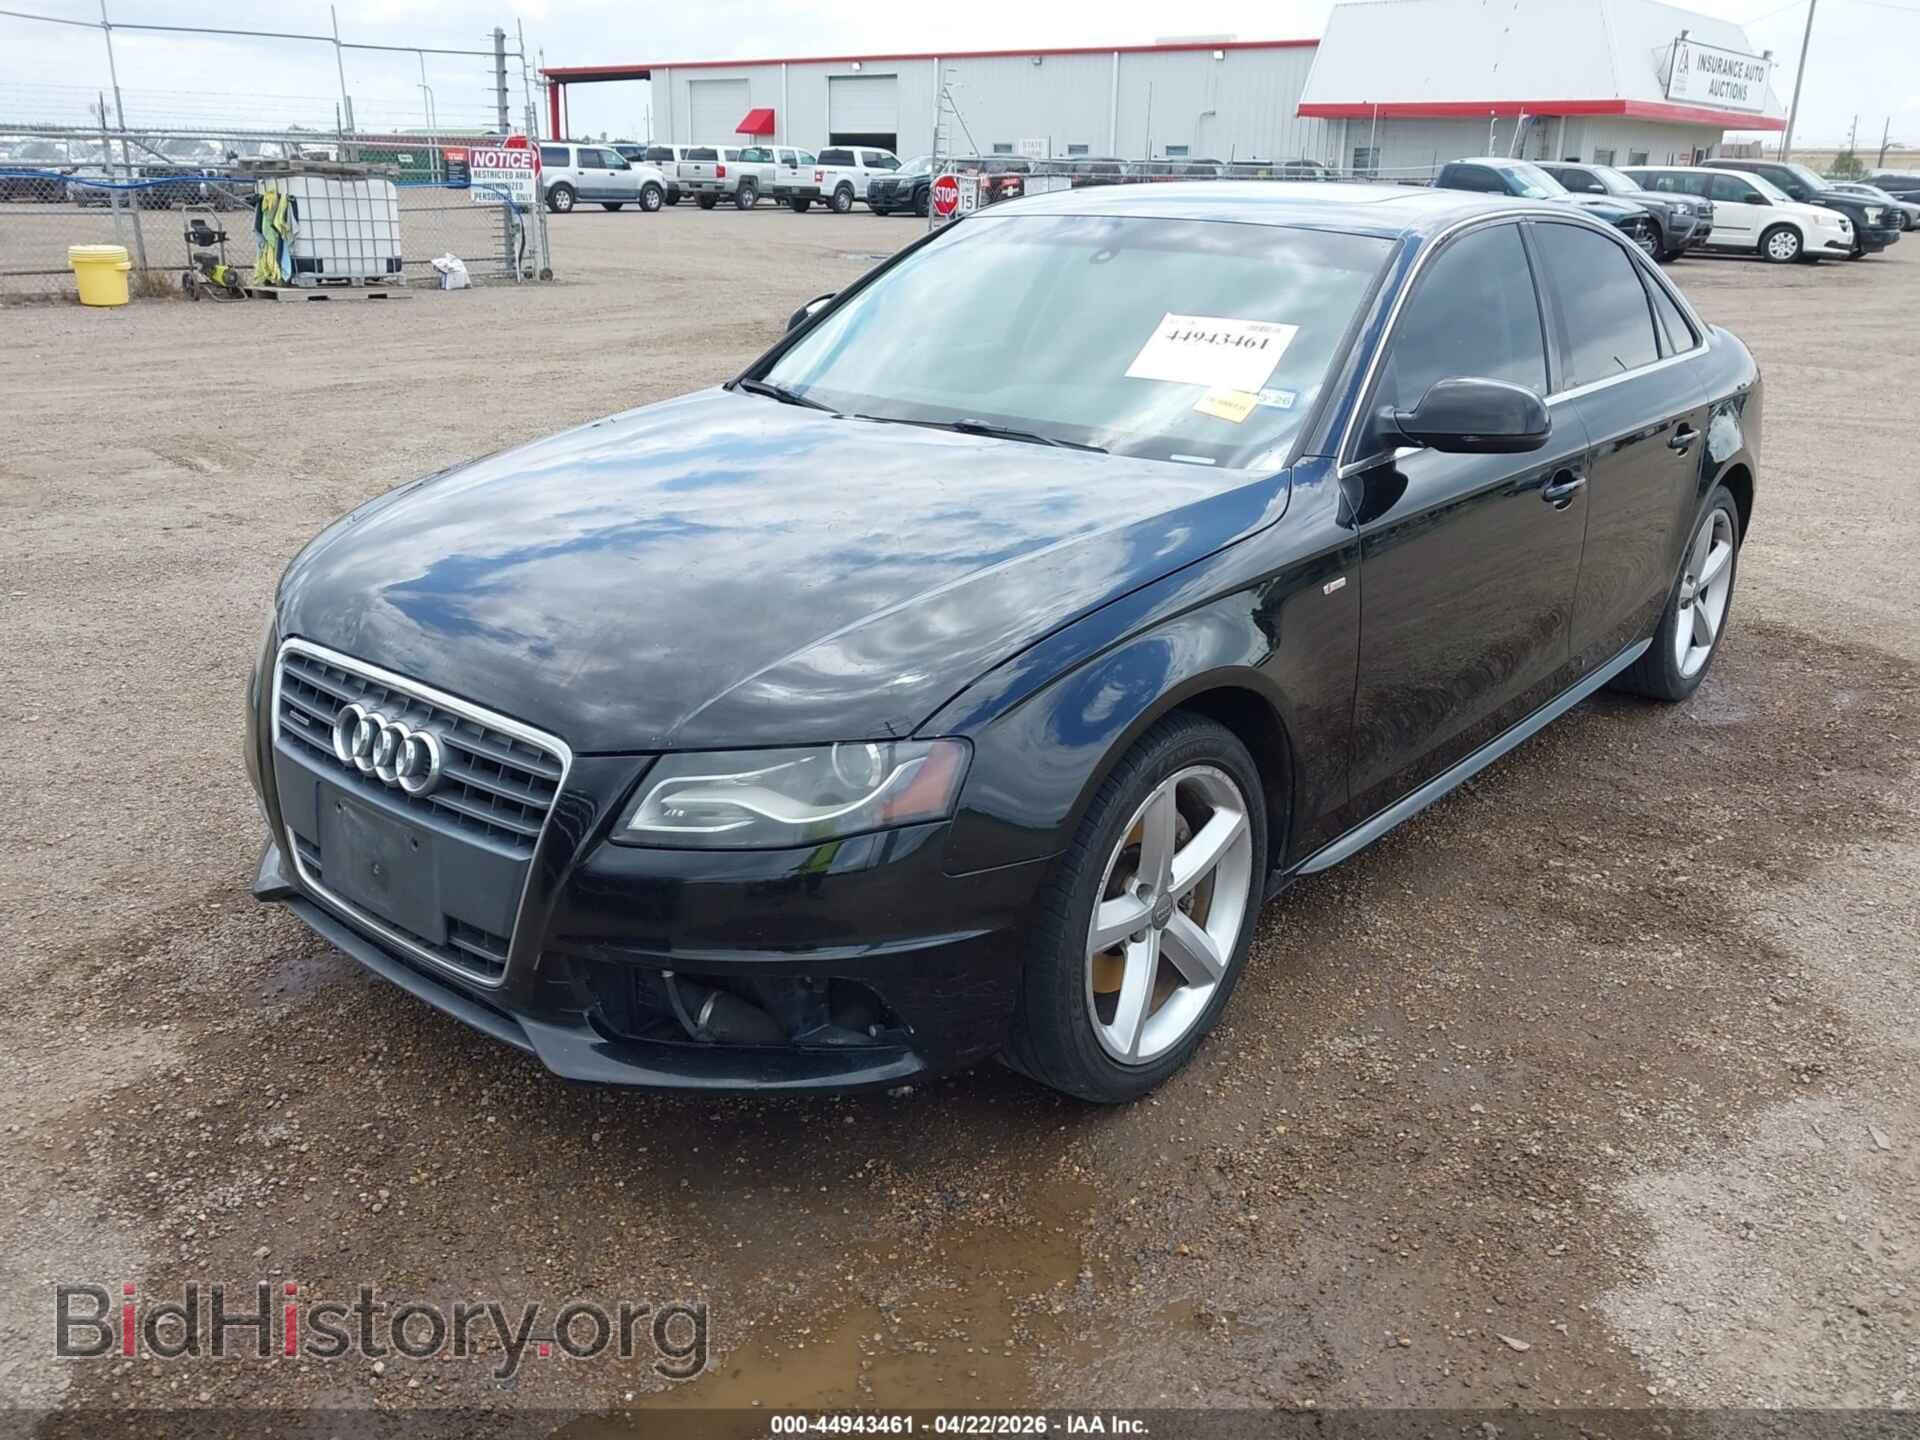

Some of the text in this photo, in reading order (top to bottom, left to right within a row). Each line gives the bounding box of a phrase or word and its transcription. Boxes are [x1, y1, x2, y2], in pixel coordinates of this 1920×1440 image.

[1697, 53, 1765, 83] INSURANCE AUTO
[1708, 79, 1748, 101] AUCTIONS
[473, 151, 532, 168] NOTICE
[473, 170, 514, 180] RESTRICTED
[515, 170, 533, 180] AREA
[934, 186, 959, 202] STOP
[961, 195, 974, 210] 15
[1166, 329, 1270, 350] 44943461
